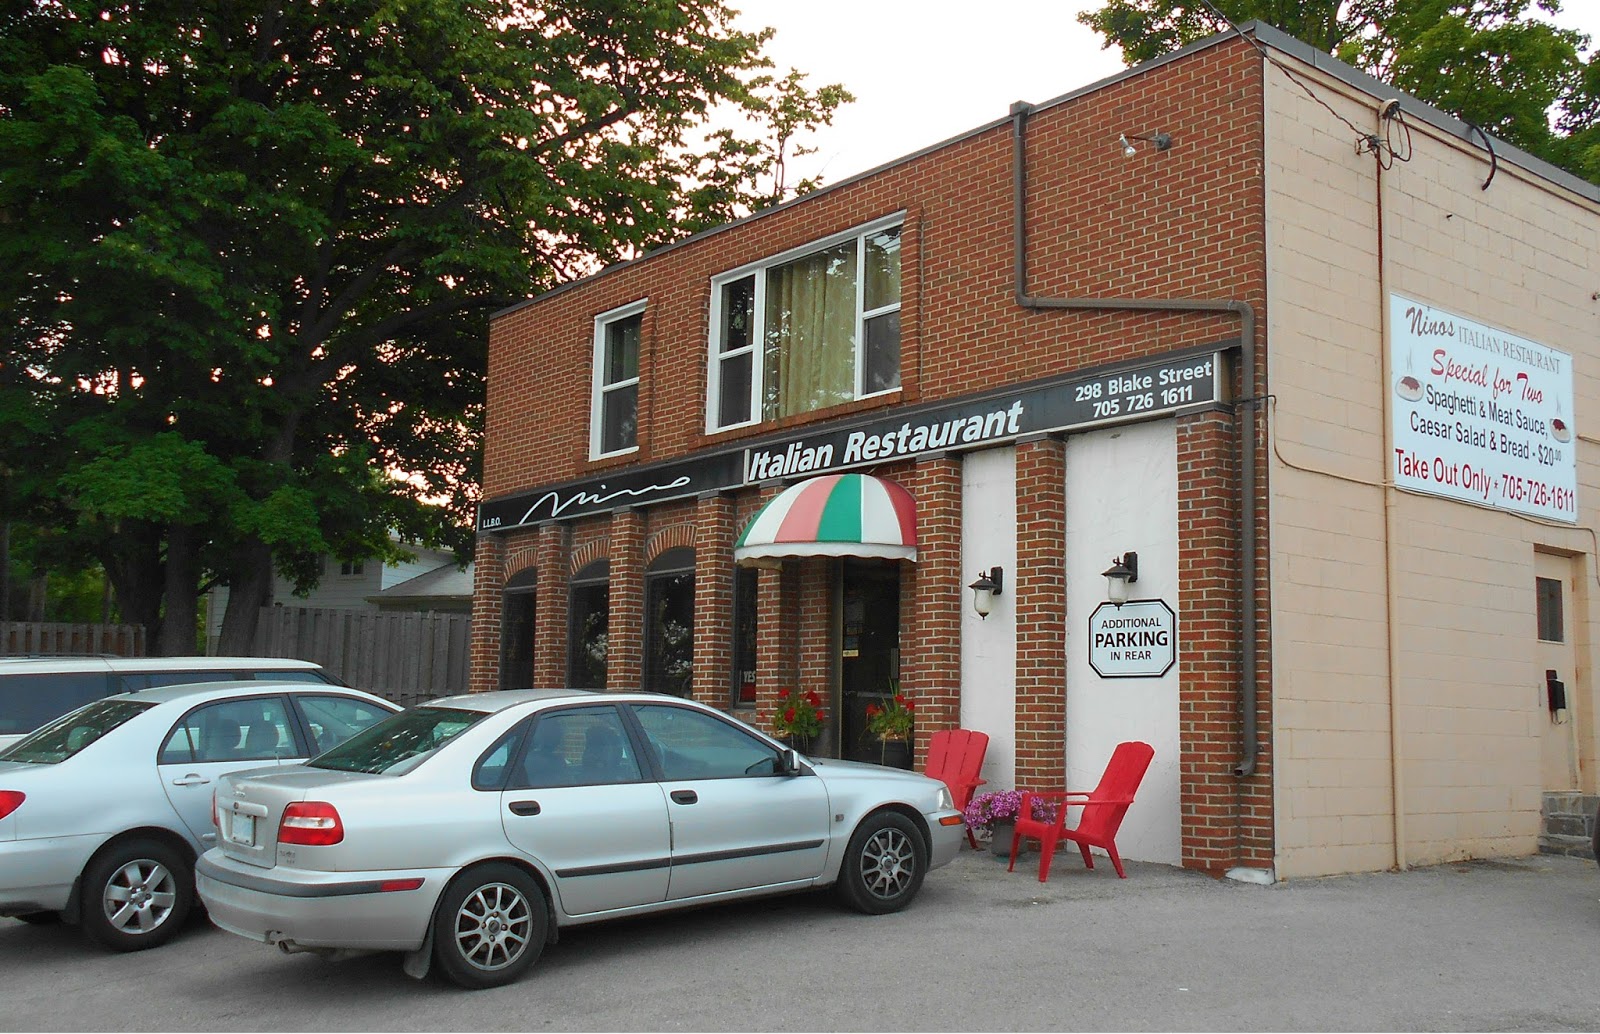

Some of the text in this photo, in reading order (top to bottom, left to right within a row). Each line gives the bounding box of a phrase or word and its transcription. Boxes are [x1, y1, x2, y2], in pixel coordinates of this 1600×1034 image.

[1406, 306, 1560, 374] Ninos ITALIAN RESTAURANT
[1075, 361, 1212, 402] 298 Blake Street
[1092, 384, 1193, 418] 705 726 1611
[1431, 348, 1543, 404] Special for Two
[1410, 410, 1452, 440] Caesar
[1456, 421, 1486, 448] Salad
[1489, 430, 1497, 451] &
[1500, 433, 1530, 460] Bread
[1426, 383, 1548, 440] Spaghetti & Meat Sauce,
[749, 400, 1024, 481] Italian Restaurant
[1395, 448, 1575, 513] Take Out Only 705-726-1611
[1095, 630, 1168, 648] PARKING
[1101, 617, 1162, 629] ADDITIONAL
[1110, 650, 1152, 661] IN REAR
